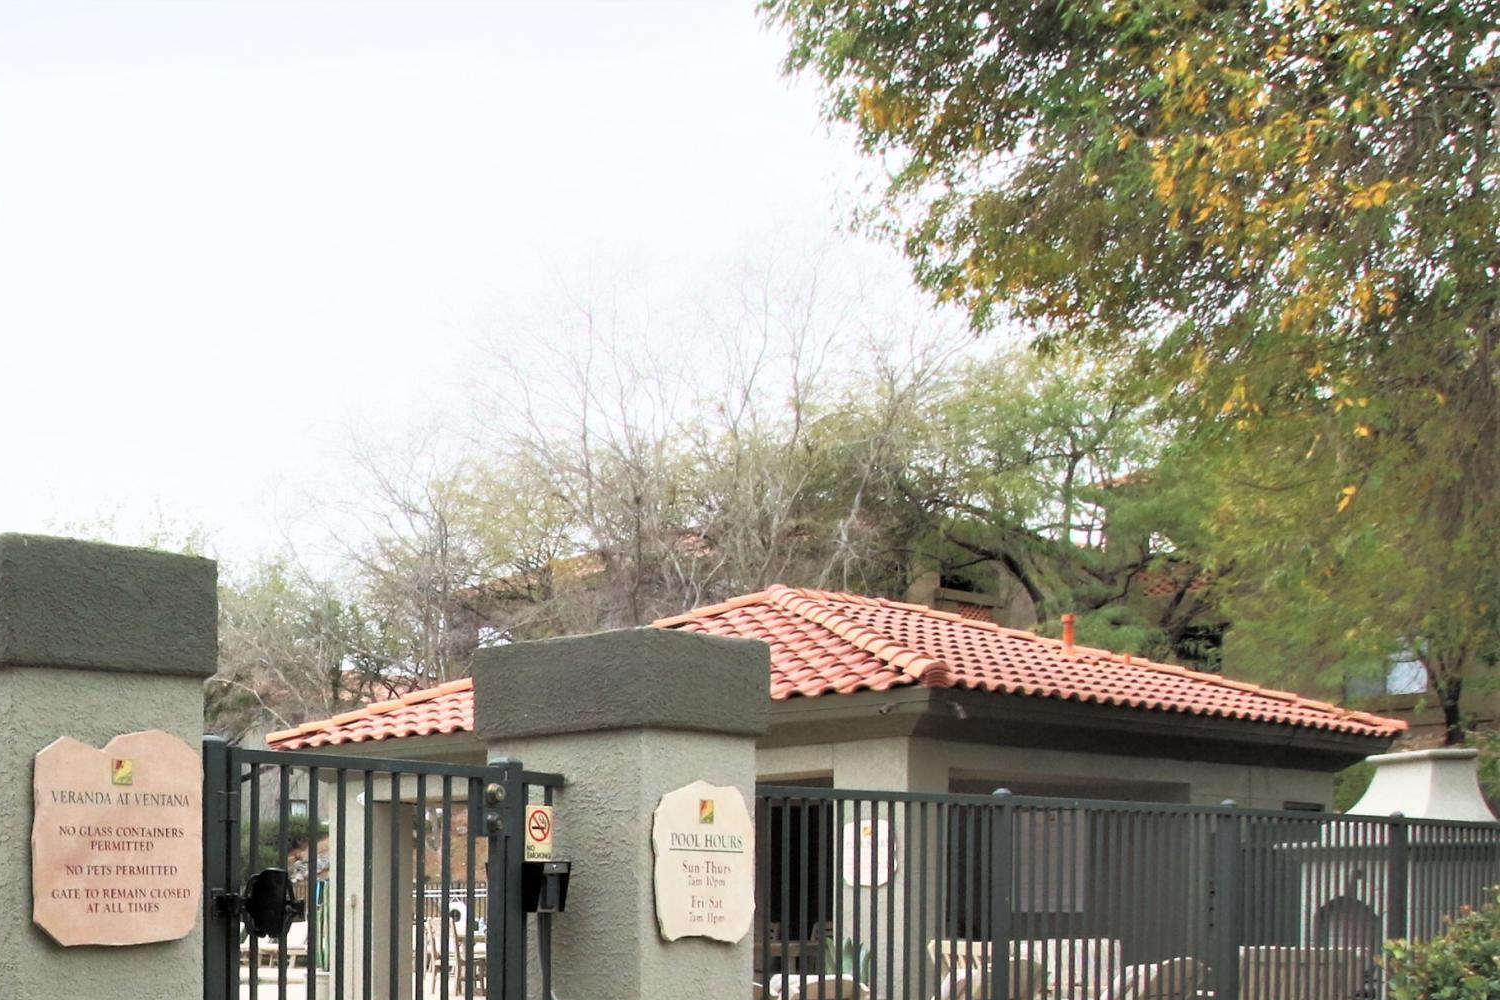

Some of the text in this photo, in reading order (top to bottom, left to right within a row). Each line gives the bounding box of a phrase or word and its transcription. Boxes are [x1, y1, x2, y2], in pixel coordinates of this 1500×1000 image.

[51, 790, 190, 808] VERANDA AT VENTANA
[59, 825, 184, 838] NO GLASS CONTAINERS
[91, 840, 154, 852] PERMITTED
[670, 833, 743, 849] POOL HOURS
[66, 865, 178, 876] NO PETS PERMITTED
[682, 860, 731, 874] Sun Thurs
[51, 888, 191, 899] GATE TO REMAIN CLOSED
[87, 903, 160, 913] AT ALL TIMES
[691, 896, 723, 909] Fri Sat
